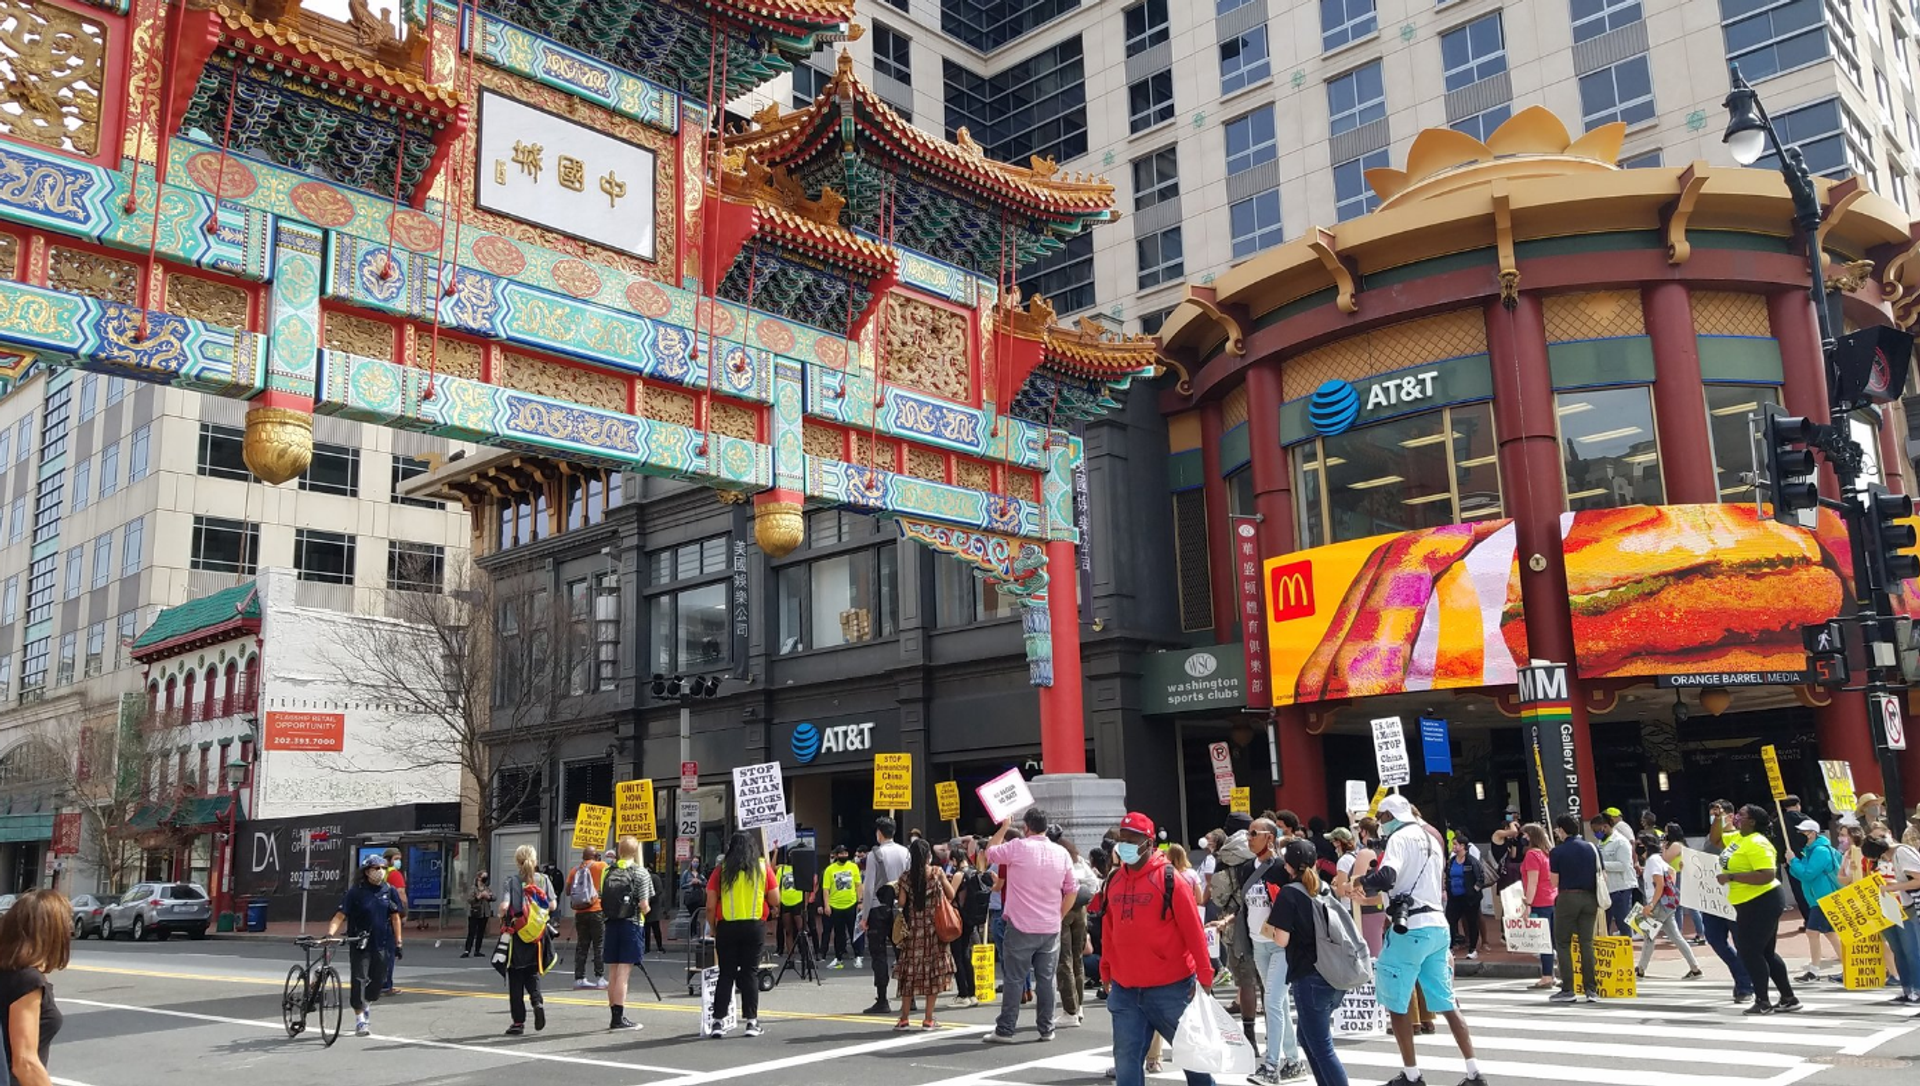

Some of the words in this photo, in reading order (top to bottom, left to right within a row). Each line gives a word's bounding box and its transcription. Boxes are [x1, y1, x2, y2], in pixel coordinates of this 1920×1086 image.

[1366, 371, 1438, 410] AT&T
[1188, 655, 1213, 675] WSC
[1816, 661, 1829, 679] 5
[1535, 668, 1567, 699] M
[1671, 675, 1720, 685] ORANGE
[1722, 673, 1763, 683] BARREL
[1767, 672, 1800, 682] MEDIA
[1167, 678, 1238, 693] washington
[1168, 691, 1204, 705] sports
[1207, 689, 1239, 700] clubs
[274, 737, 335, 745] 202.393.7000
[821, 722, 875, 753] AT&T
[1378, 739, 1401, 751] STOP
[1560, 723, 1575, 771] Gallery
[740, 765, 774, 777] STOP
[876, 763, 909, 773] Demonizing
[740, 775, 777, 787] ANTI-
[882, 772, 903, 780] China
[622, 784, 645, 793] UNITE
[739, 783, 780, 797] ASIAN
[625, 794, 642, 802] NOW
[740, 794, 782, 808] ATTACKS
[1566, 775, 1581, 820] Pl-Chi
[585, 806, 607, 815] UNITE
[621, 802, 648, 811] AGAINST
[745, 804, 778, 817] NOW
[622, 813, 648, 822] RACIST
[579, 820, 606, 828] AGAINST
[619, 823, 652, 832] VIOLENCE
[682, 821, 697, 834] 25
[579, 827, 604, 836] RACIST
[1853, 885, 1877, 916] Chinese
[1831, 894, 1863, 939] Demonizing
[1846, 897, 1868, 926] China
[1505, 919, 1522, 929] UDC
[1827, 911, 1846, 932] STOP
[1851, 944, 1880, 955] RACIST
[1851, 957, 1881, 967] AGAINST
[1858, 967, 1876, 976] NOW
[1855, 977, 1880, 988] UNITE
[1340, 999, 1376, 1008] ASIAN
[1340, 1010, 1374, 1019] ANTI-
[1340, 1021, 1373, 1031] STOP
